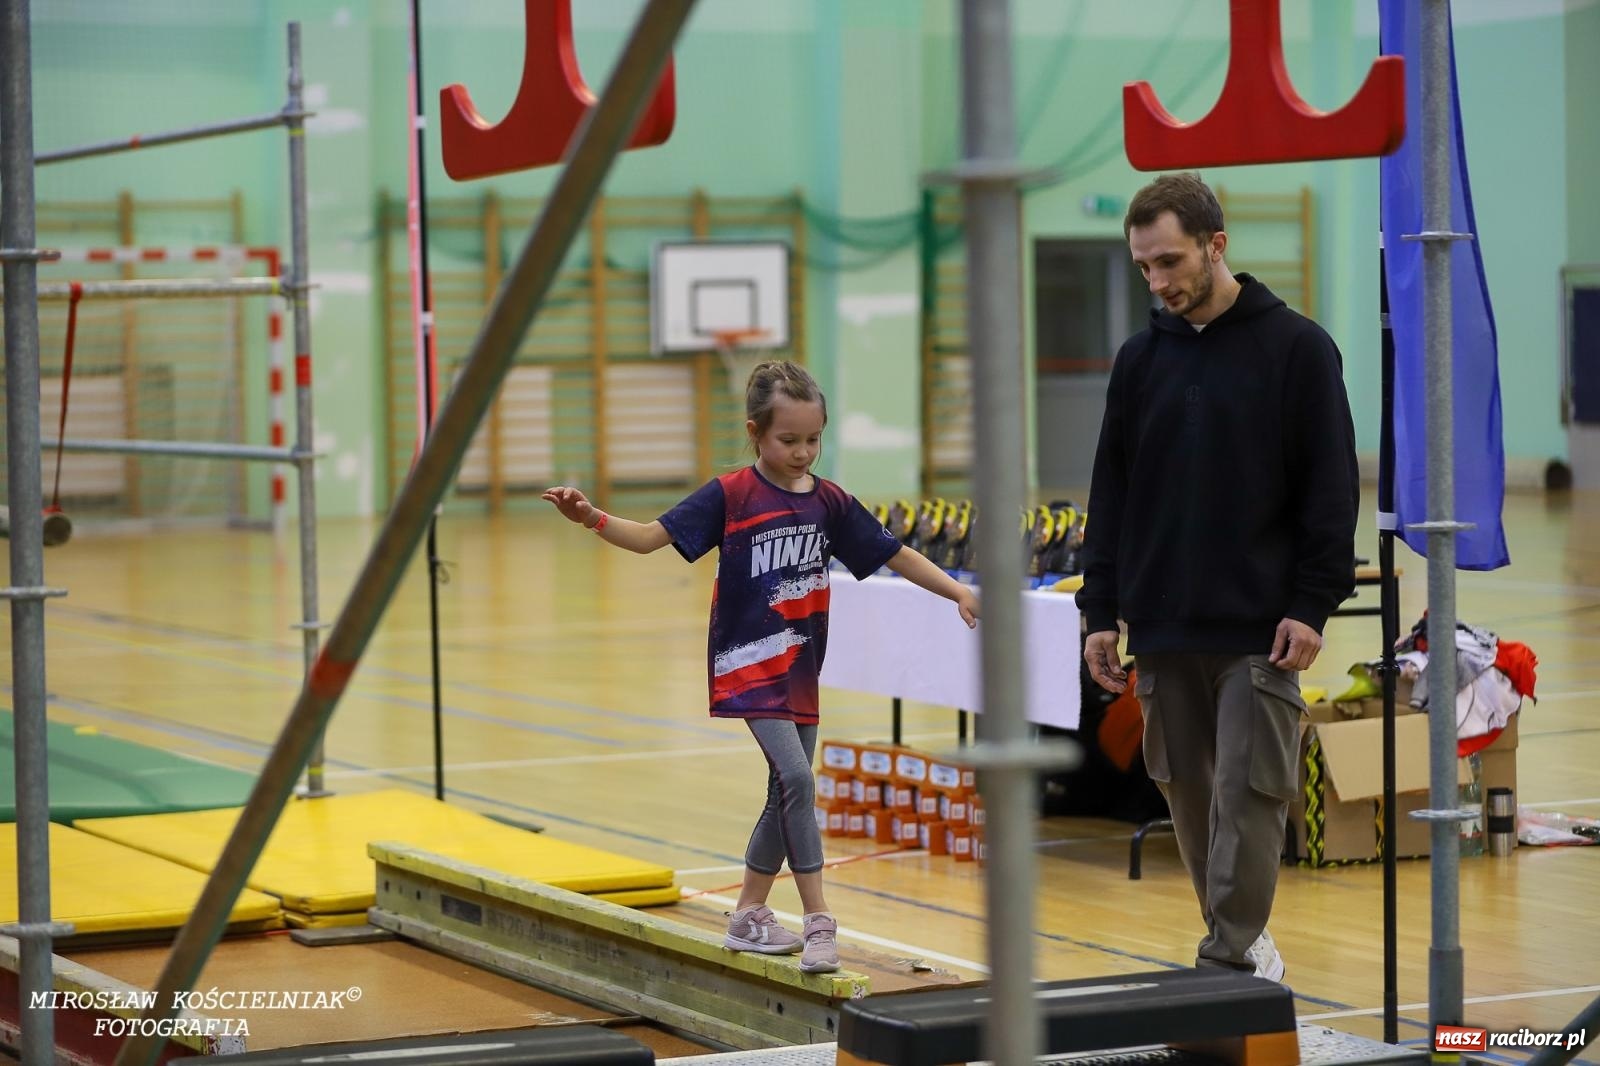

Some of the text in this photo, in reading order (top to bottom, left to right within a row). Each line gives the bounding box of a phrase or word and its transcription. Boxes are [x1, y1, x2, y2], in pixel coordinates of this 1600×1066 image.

[755, 526, 797, 544] MISTRZOSTWA
[797, 523, 817, 534] POLSKI
[751, 532, 823, 578] NINJA
